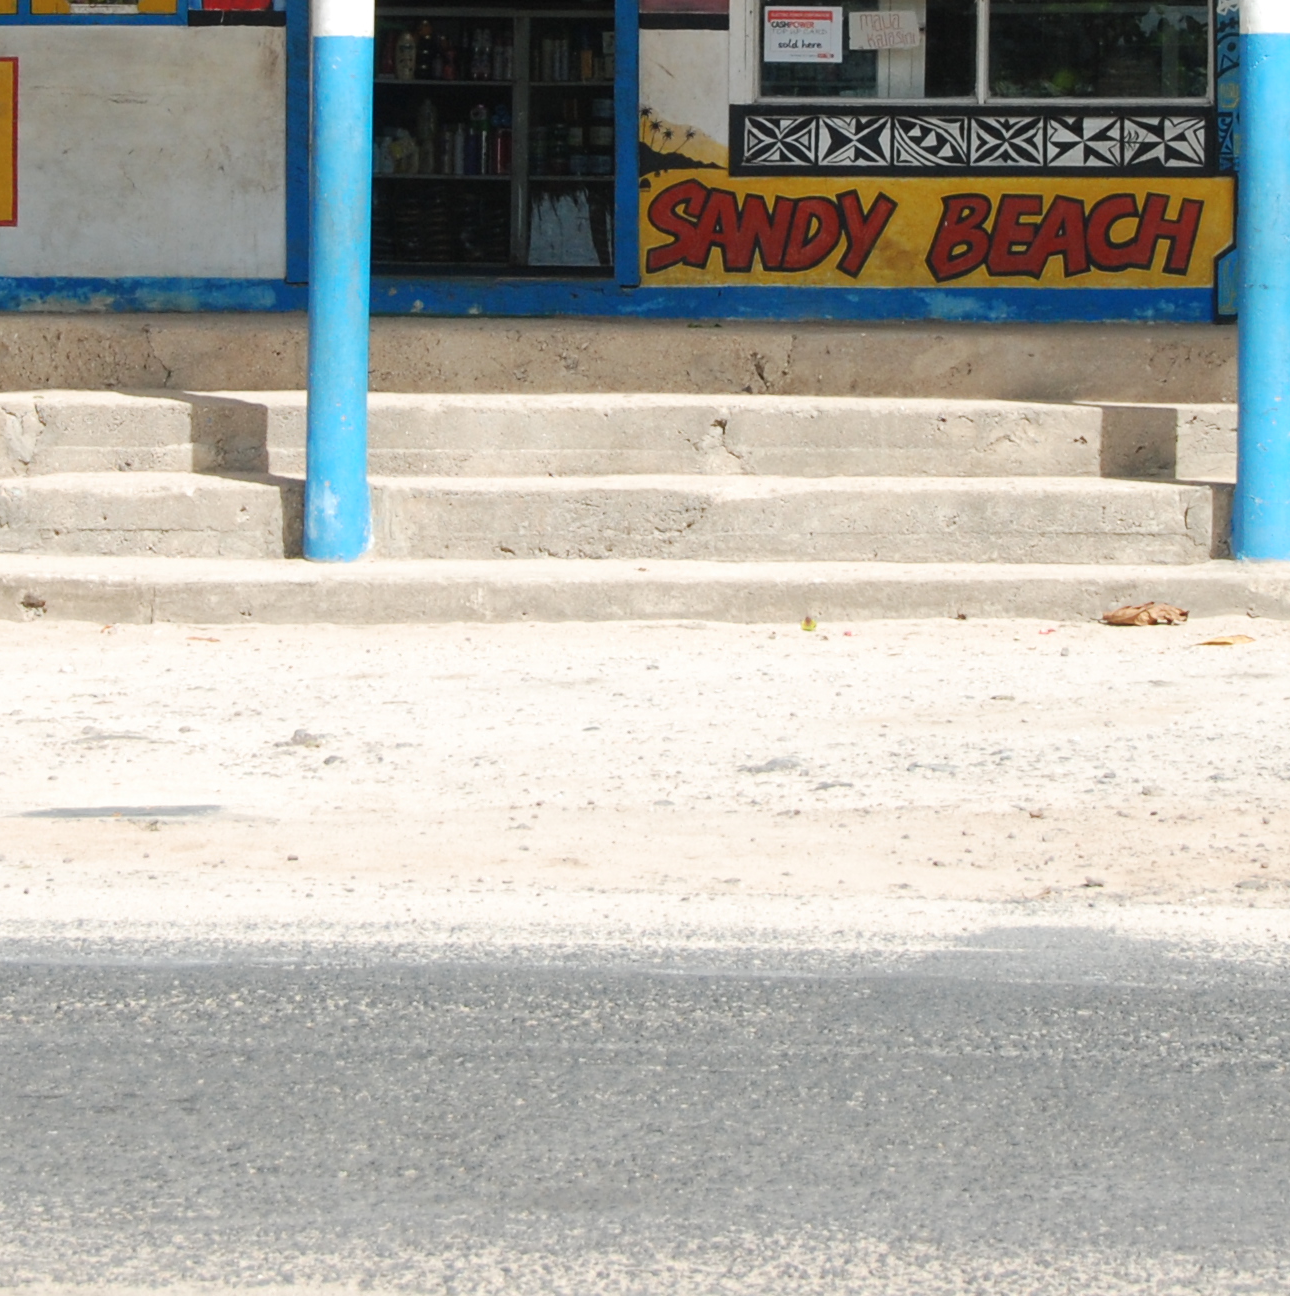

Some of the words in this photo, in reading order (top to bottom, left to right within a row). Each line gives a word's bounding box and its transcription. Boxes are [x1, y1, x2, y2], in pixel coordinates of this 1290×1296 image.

[778, 39, 799, 49] sold
[801, 39, 822, 49] here
[646, 178, 898, 279] SANDY
[925, 191, 1203, 282] BEACH
